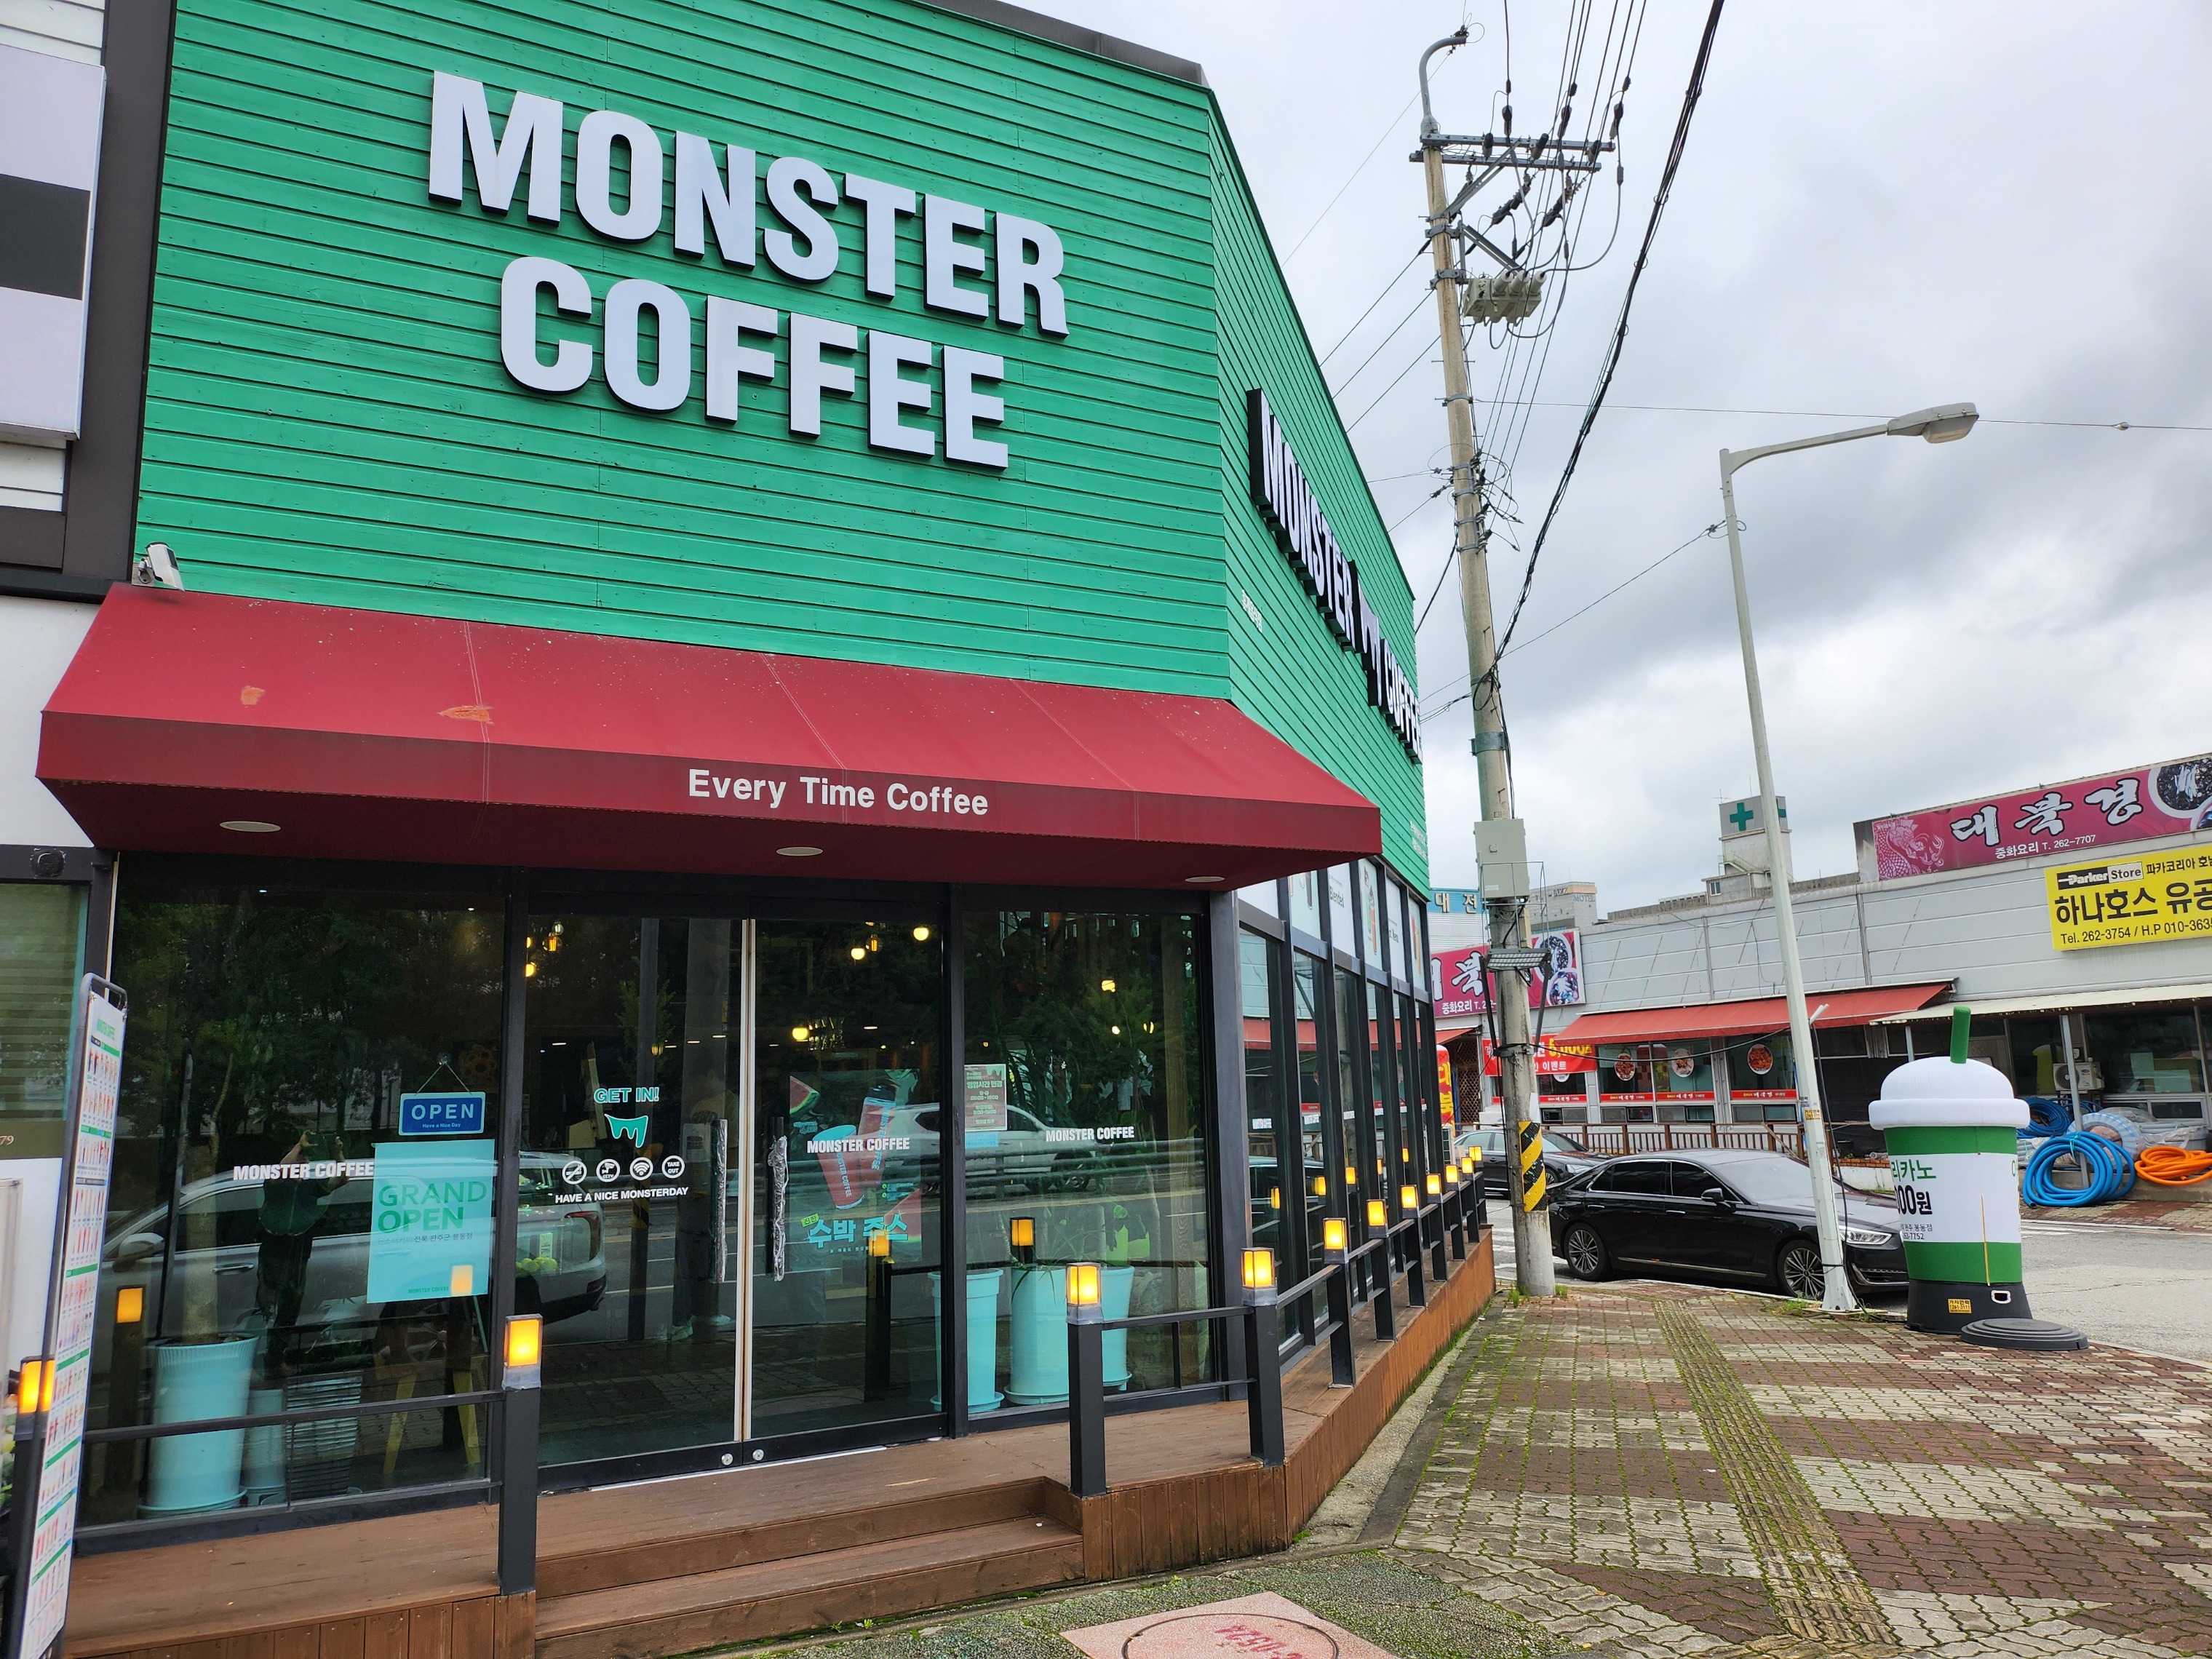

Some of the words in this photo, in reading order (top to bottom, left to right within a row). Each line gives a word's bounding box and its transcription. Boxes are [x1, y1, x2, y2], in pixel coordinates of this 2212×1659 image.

[428, 71, 1070, 338] MONSTER
[500, 256, 1008, 470] COFFEE
[1247, 388, 1356, 653] MONSTER
[689, 768, 787, 808] Every
[800, 776, 875, 808] Time
[886, 783, 988, 815] Coffee
[1995, 842, 2039, 859] 중화요리
[2053, 835, 2096, 849] 262-7707
[2110, 867, 2141, 880] Store
[2147, 858, 2195, 875] 파카코리아
[1573, 894, 1596, 902] MOTEL
[2054, 888, 2158, 926] 하나호스
[2061, 933, 2080, 944] Tel.
[2082, 927, 2131, 942] 262-3754
[2141, 923, 2161, 936] H.P
[1442, 999, 1473, 1016] 중화요리
[1543, 1060, 1567, 1072] 이벤트
[594, 1088, 632, 1103] GET
[635, 1087, 659, 1102] IN!
[411, 1103, 474, 1121] OPEN
[1046, 1129, 1095, 1142] MONSTER
[1097, 1126, 1135, 1140] COFFEE
[807, 1139, 864, 1153] MONSTER
[867, 1137, 910, 1151] COFFEE
[233, 1163, 310, 1181] MONSTER
[315, 1161, 374, 1178] COFFEE
[378, 1181, 487, 1206] GRAND
[555, 1193, 583, 1204] HAVE
[584, 1193, 592, 1201] A
[594, 1190, 618, 1201] NICE
[621, 1187, 689, 1200] MONSTERDAY
[378, 1207, 464, 1233] OPEN
[414, 1234, 428, 1243] 전북
[430, 1233, 450, 1242] 완주군
[808, 1220, 856, 1249] 수박
[863, 1214, 909, 1241] 주스
